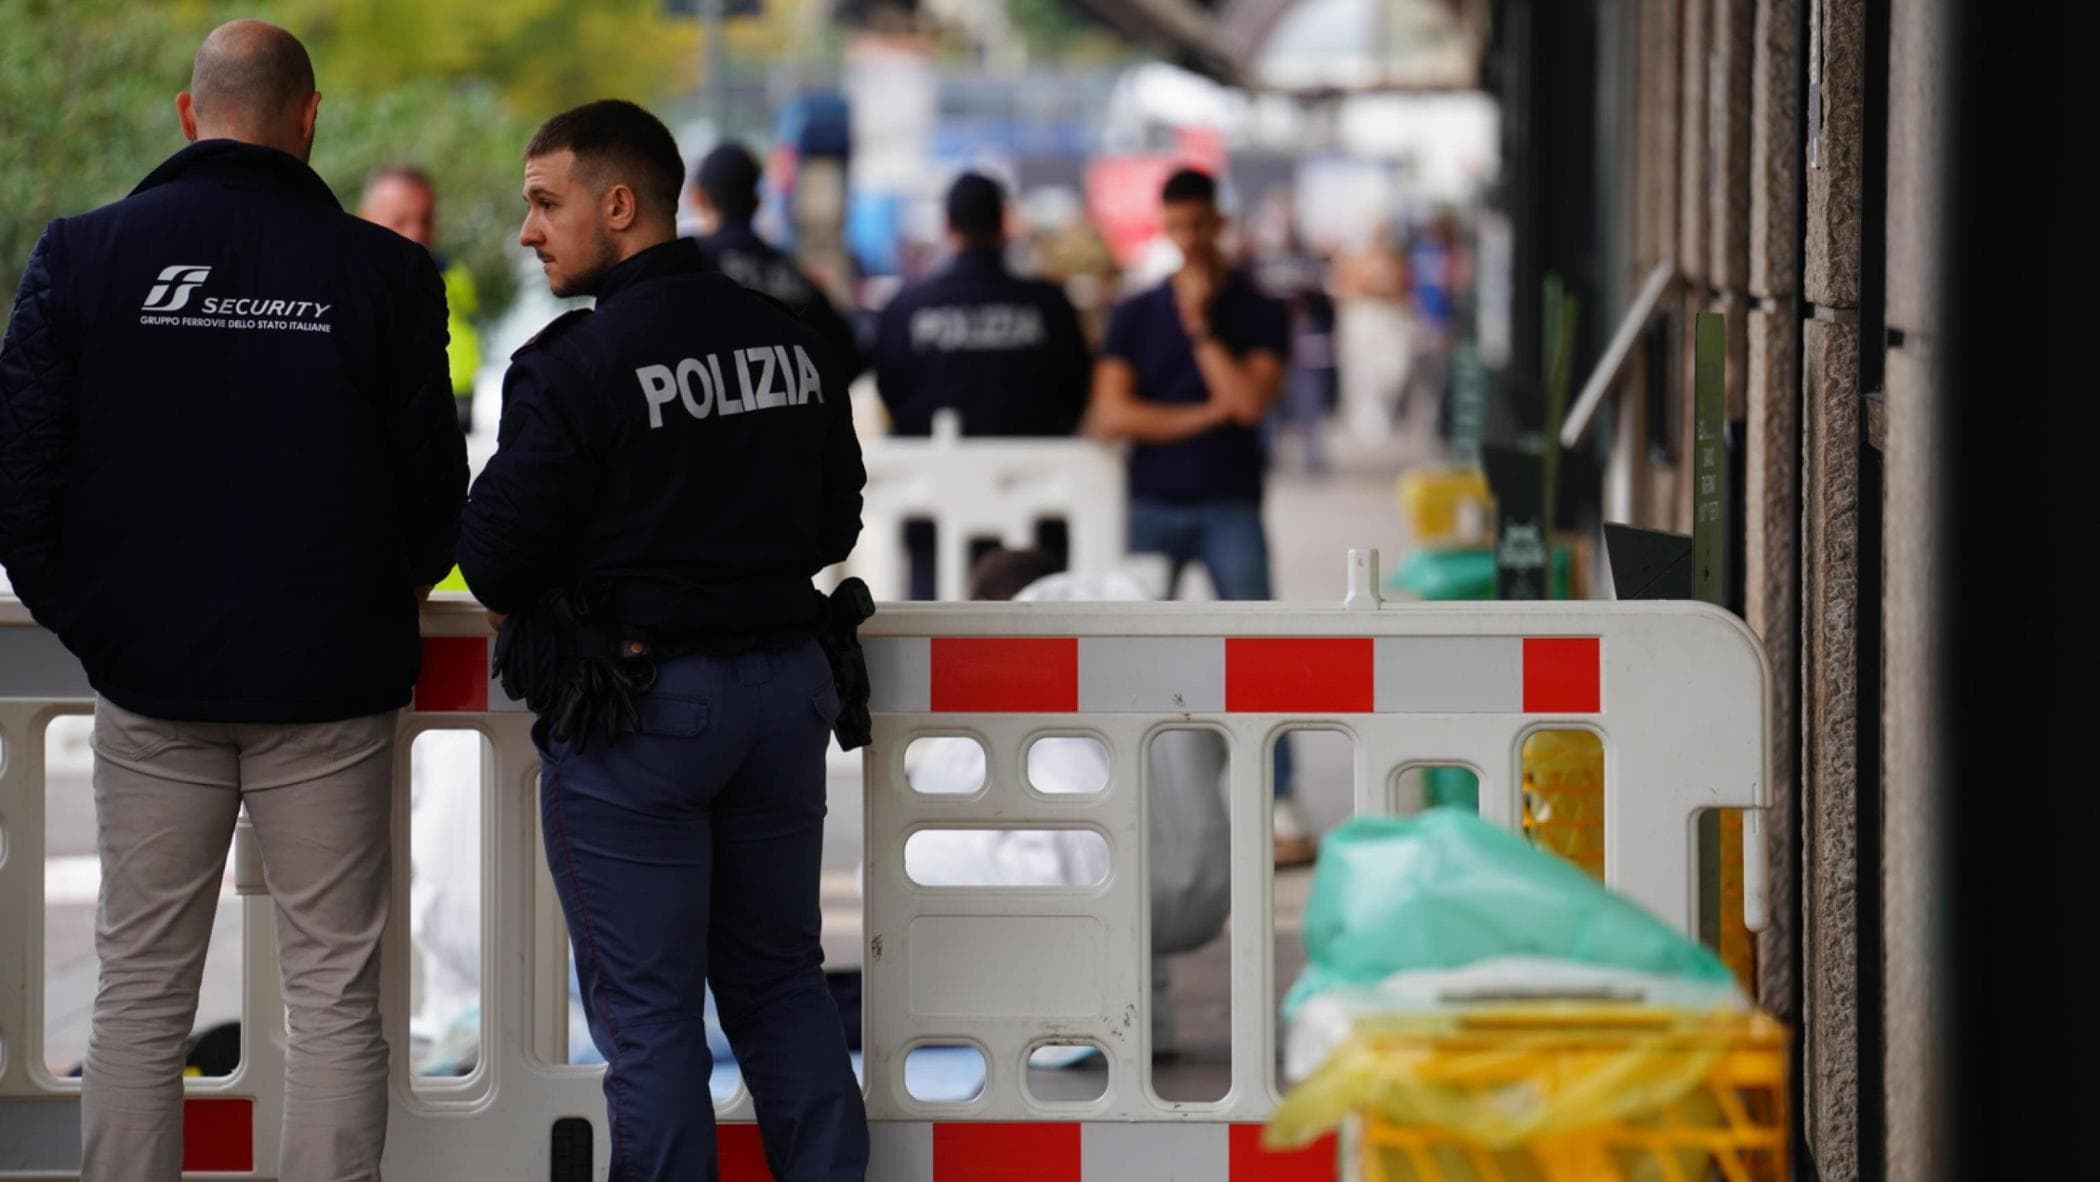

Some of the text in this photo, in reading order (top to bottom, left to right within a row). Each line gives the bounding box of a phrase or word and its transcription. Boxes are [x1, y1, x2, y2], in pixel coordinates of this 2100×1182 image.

[201, 297, 332, 318] SECURITY
[140, 315, 332, 333] GRUPPO FERROVIE DELLO STATO ITALIANE
[635, 344, 825, 430] POLIZIA
